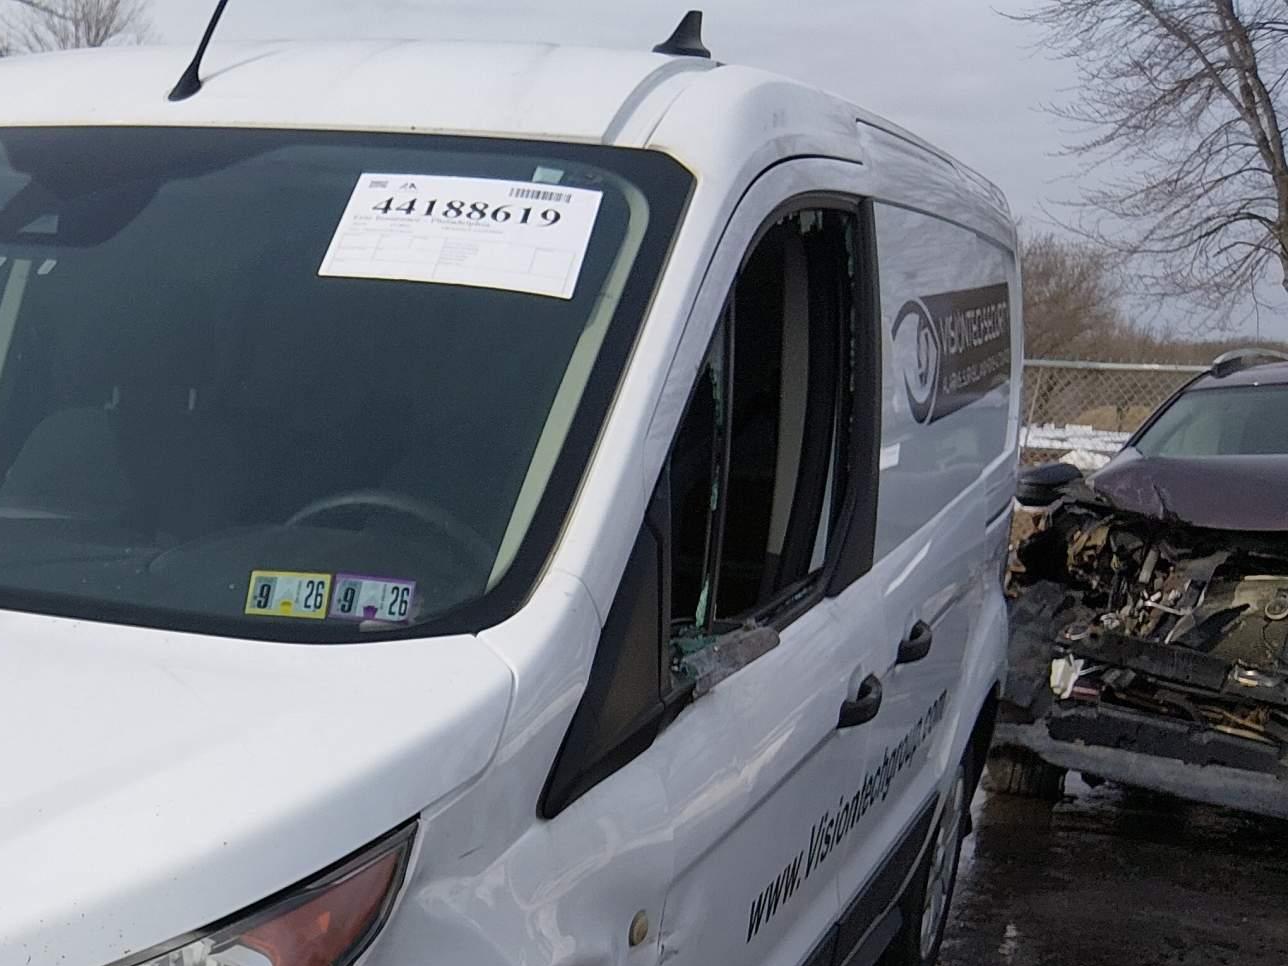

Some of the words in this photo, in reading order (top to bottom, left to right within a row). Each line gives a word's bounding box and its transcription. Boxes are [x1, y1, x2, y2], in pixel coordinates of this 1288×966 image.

[372, 196, 561, 227] 44188619
[257, 583, 271, 609] 9
[304, 580, 325, 610] 26
[340, 587, 356, 613] 9
[388, 585, 410, 616] 26
